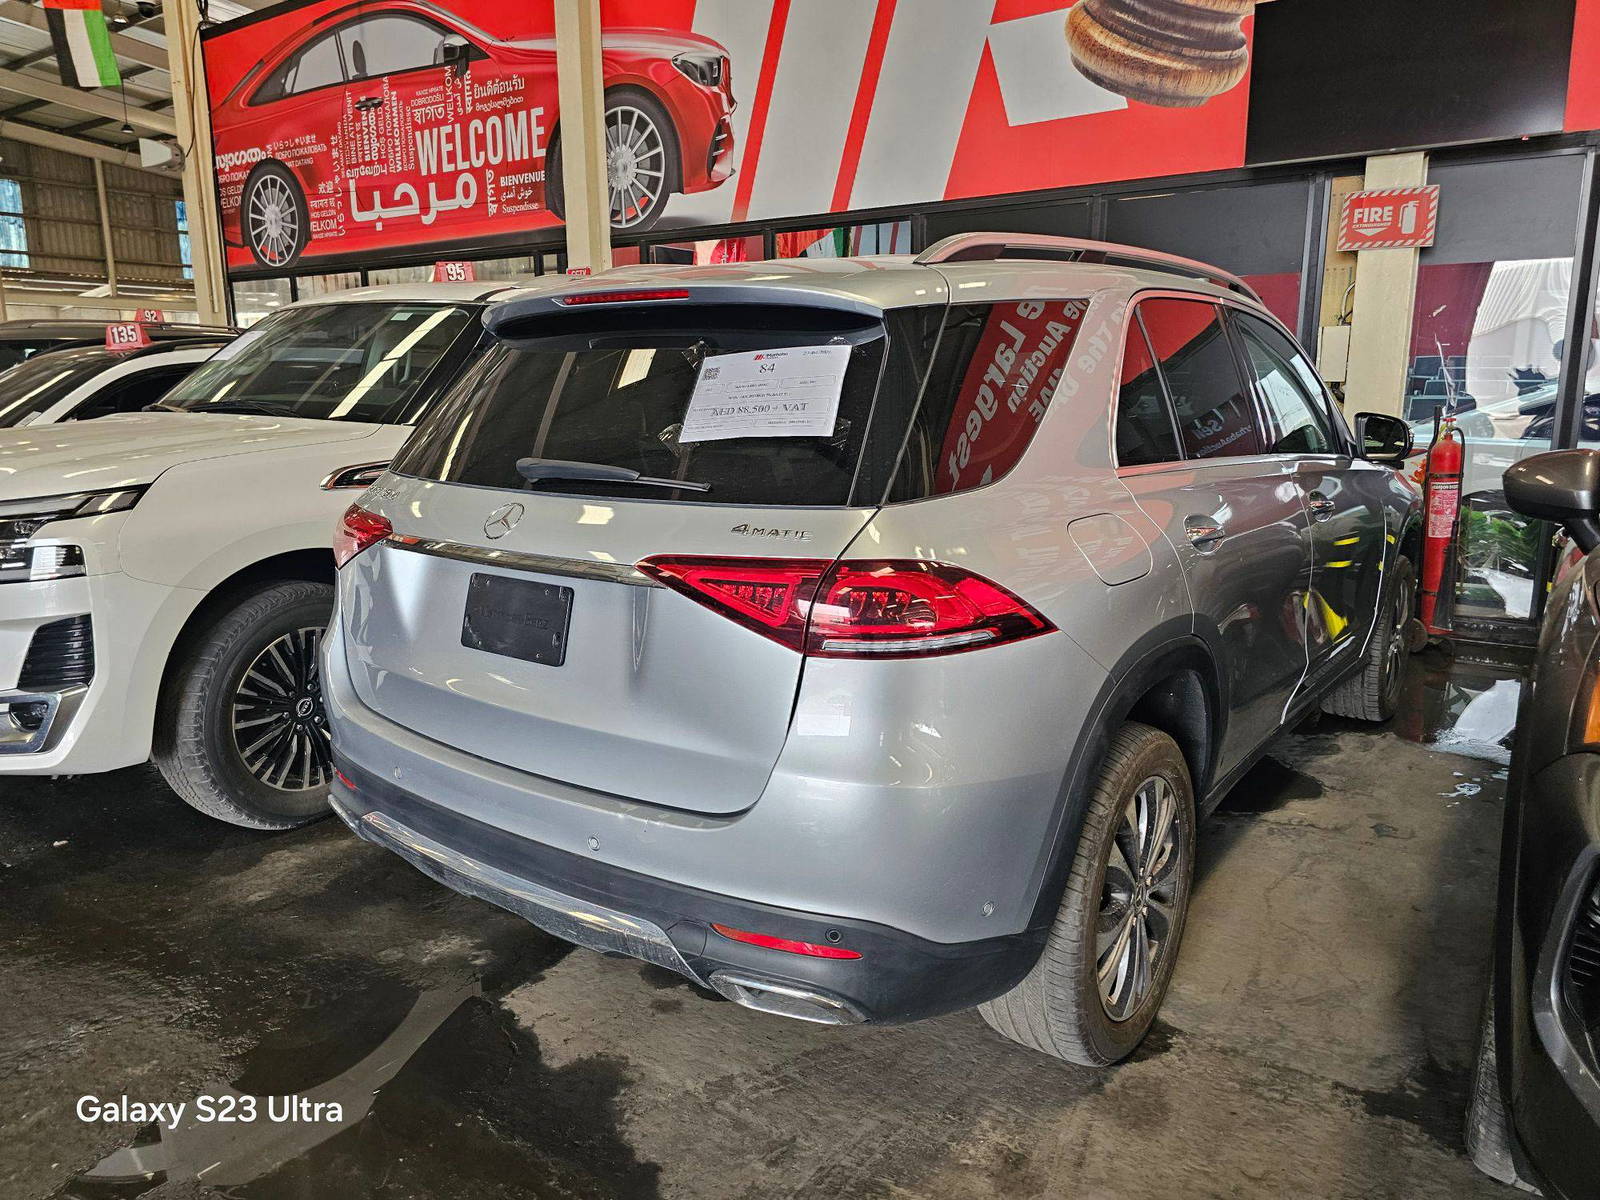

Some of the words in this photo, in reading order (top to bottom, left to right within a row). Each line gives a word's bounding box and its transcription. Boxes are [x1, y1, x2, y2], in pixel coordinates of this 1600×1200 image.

[445, 65, 454, 123] WELKOM
[360, 96, 371, 161] BIENVENE
[391, 90, 403, 172] WILLKOMMEN
[415, 107, 546, 176] WELCOME
[350, 140, 358, 164] BINE
[500, 171, 546, 187] BIENVENUE
[349, 172, 477, 231] مرحبا
[1353, 205, 1393, 224] FIRE
[446, 263, 465, 280] 95
[144, 310, 158, 322] 92
[112, 325, 137, 344] 135
[759, 363, 776, 374] 84
[782, 402, 808, 412] VAT
[731, 523, 813, 541] 4MATIC
